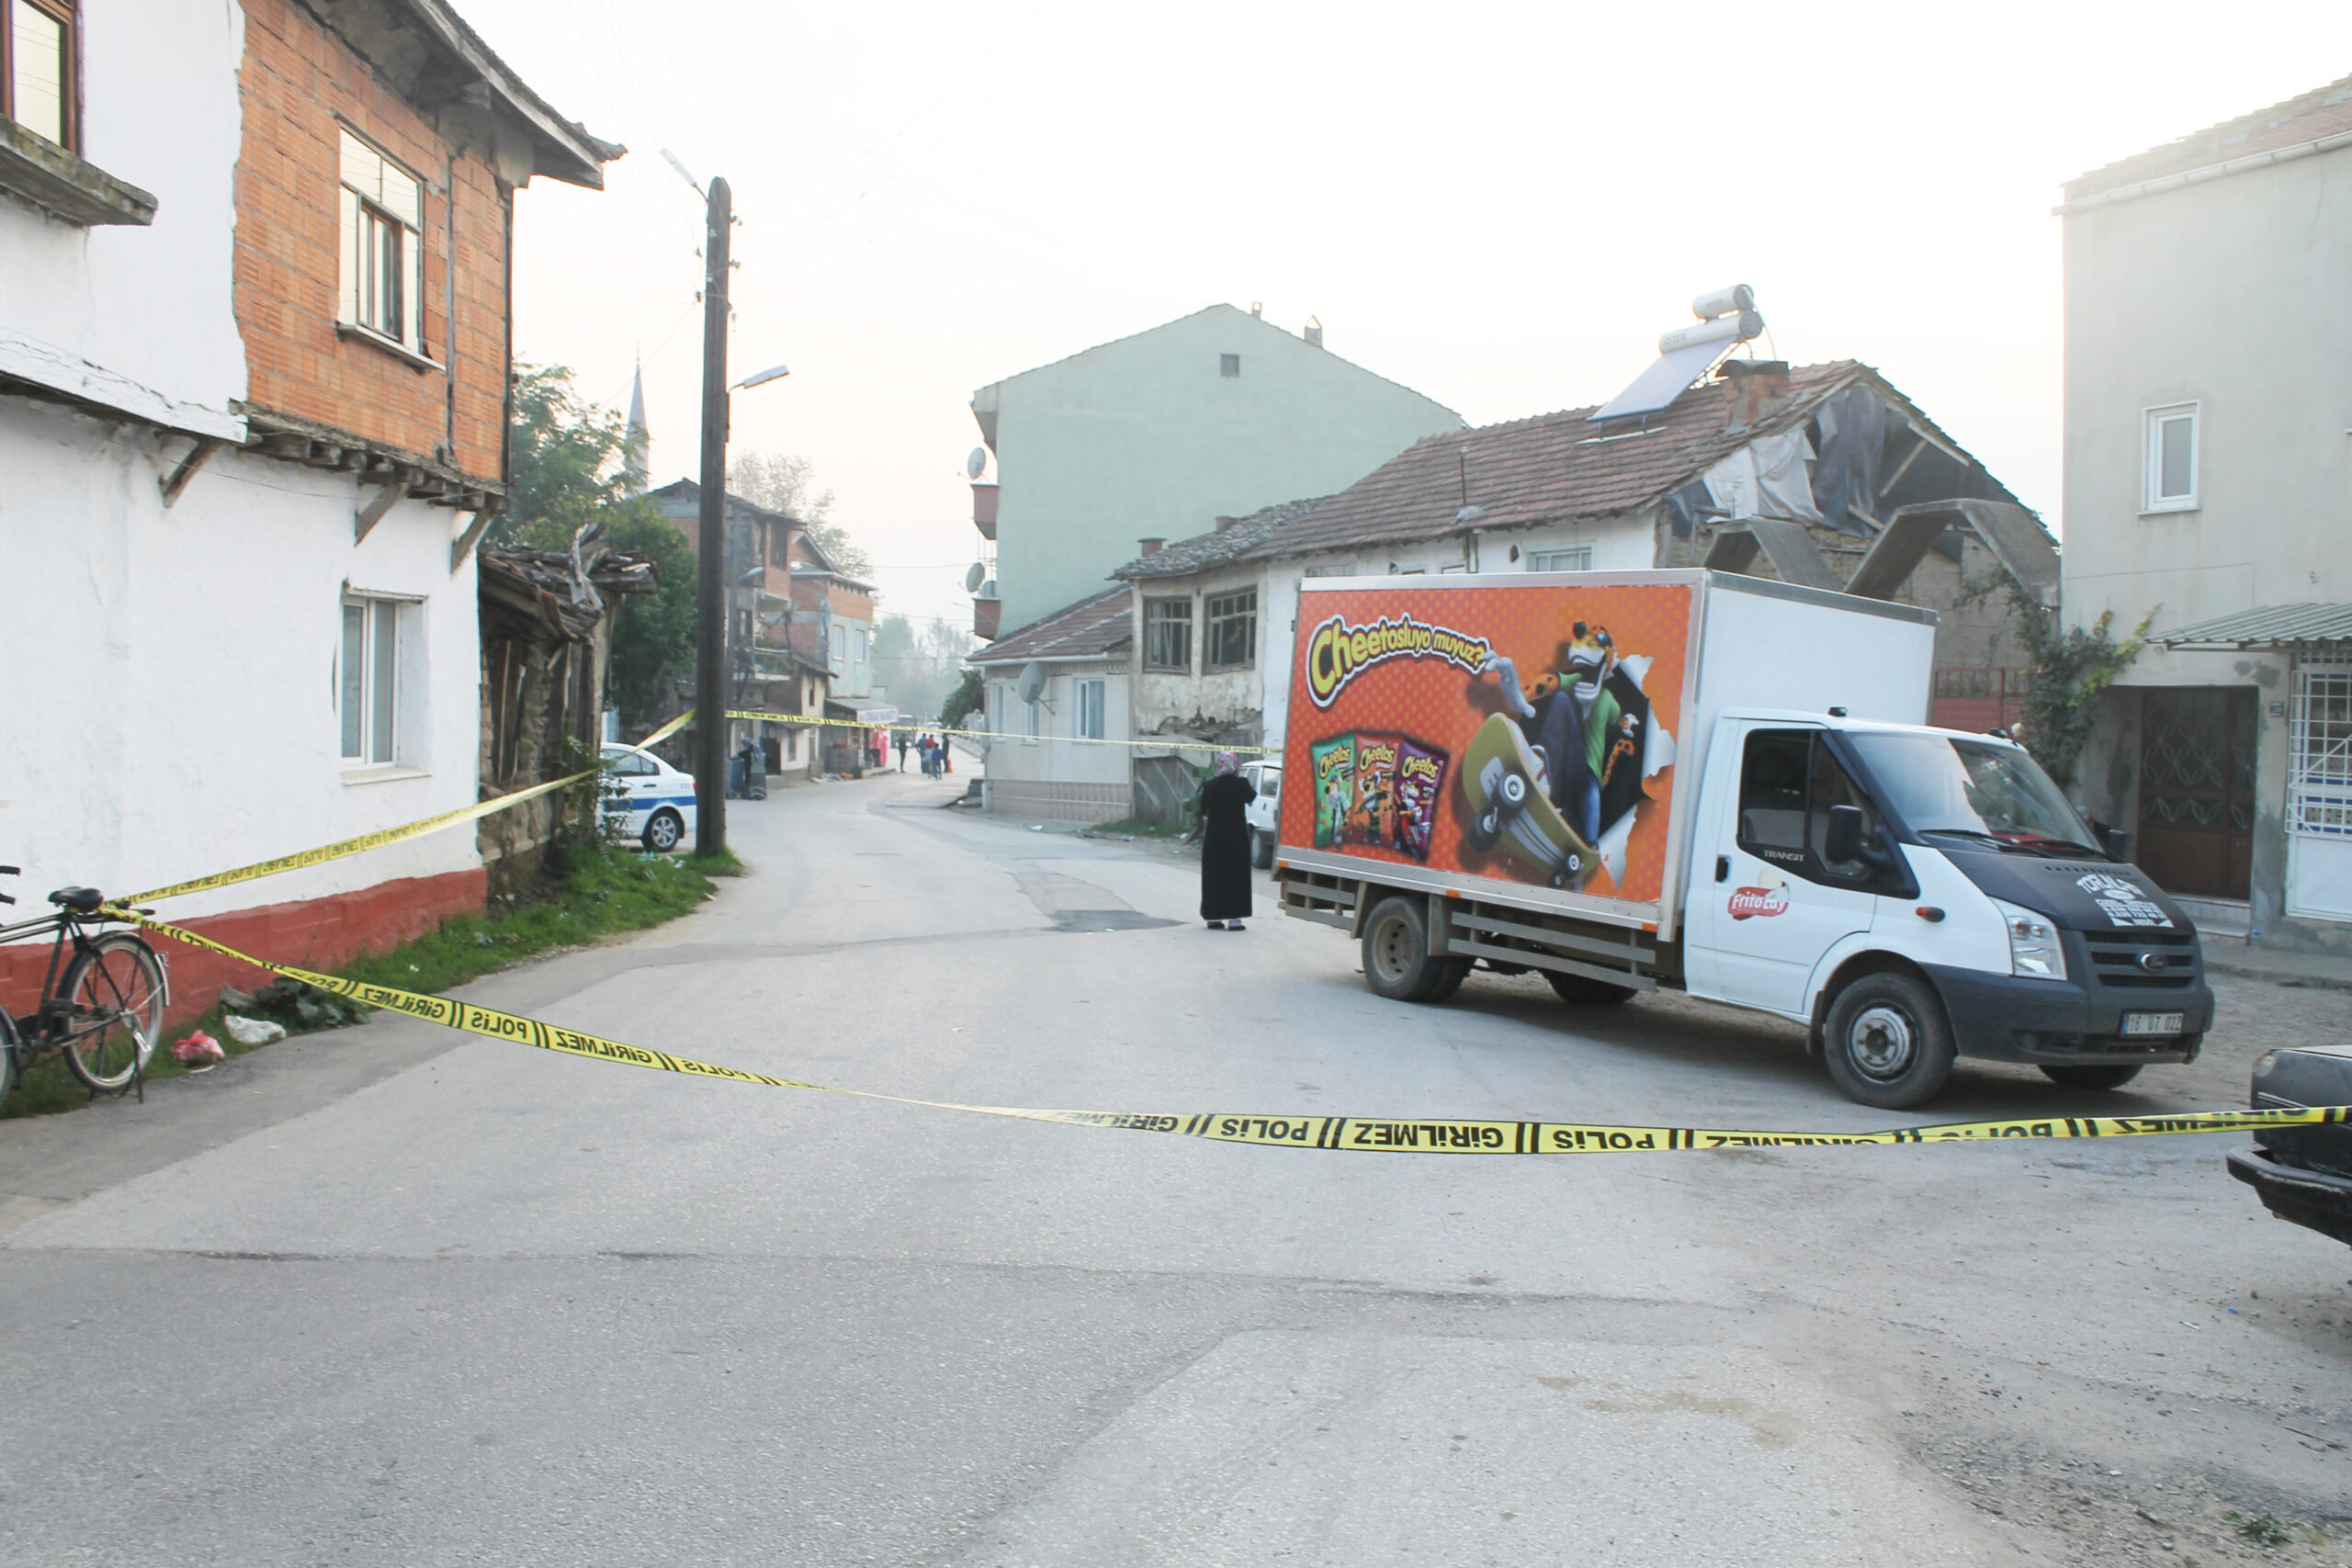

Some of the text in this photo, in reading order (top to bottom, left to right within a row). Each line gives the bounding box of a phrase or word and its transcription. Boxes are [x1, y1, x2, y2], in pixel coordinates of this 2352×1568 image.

[1309, 617, 1487, 698] Cheetosluyo muyuz?
[1318, 745, 1351, 779] Cheetos
[1359, 743, 1395, 772] Cheetos
[1401, 753, 1440, 779] Cheetos
[1763, 849, 1805, 863] TRANSIT
